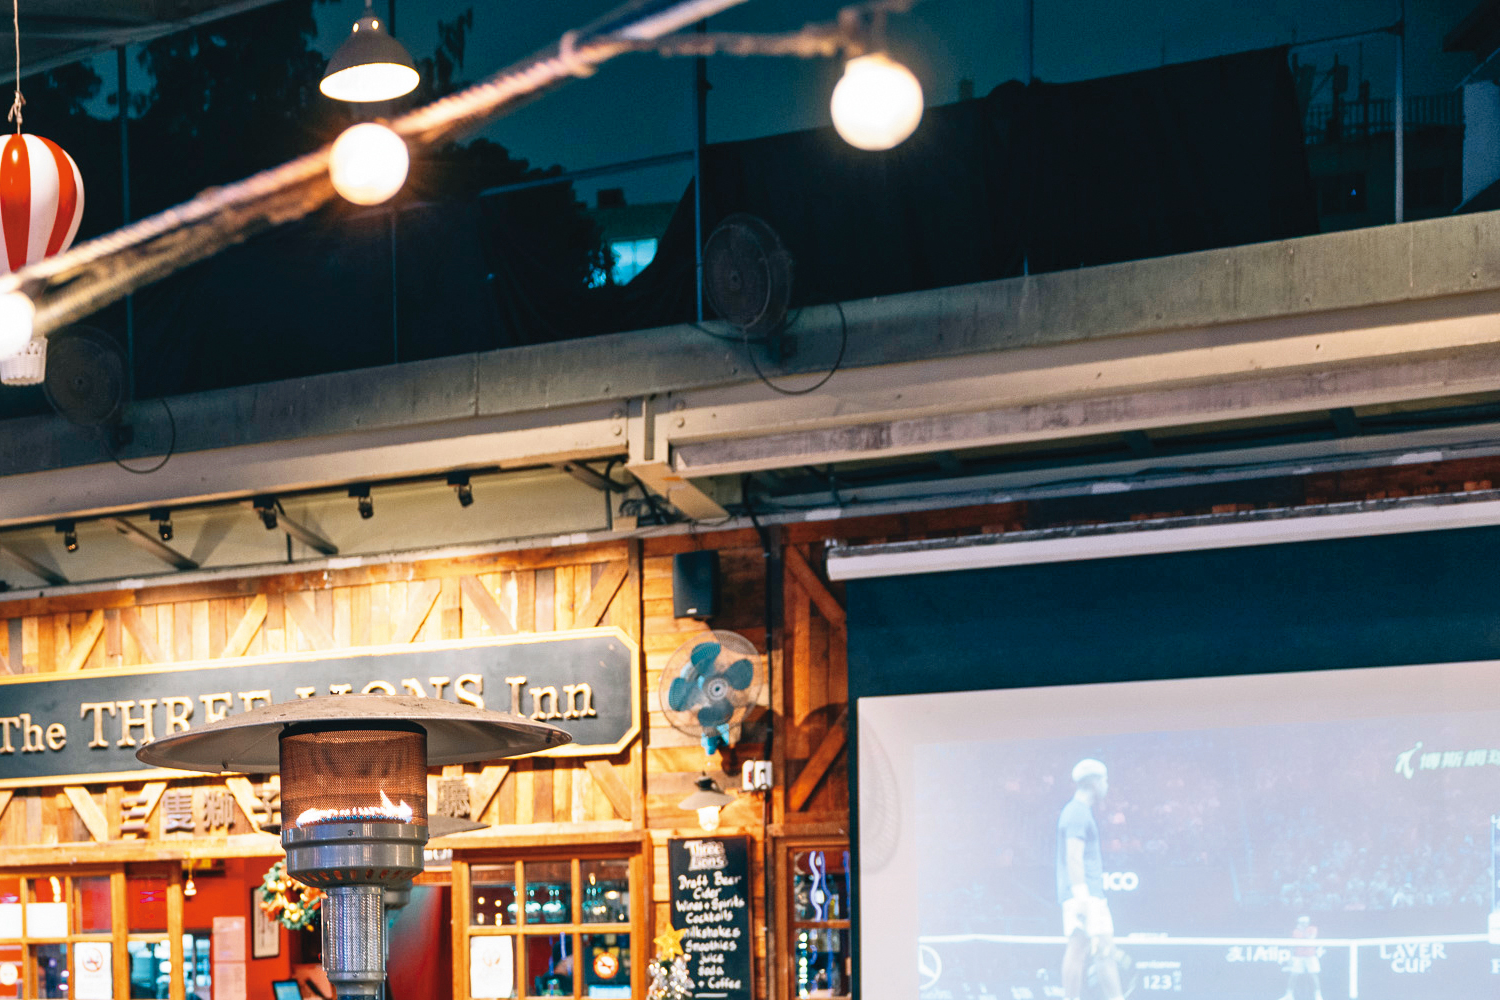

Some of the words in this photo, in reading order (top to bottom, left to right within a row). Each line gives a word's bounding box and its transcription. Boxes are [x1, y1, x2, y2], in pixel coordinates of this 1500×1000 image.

[505, 676, 597, 722] Inn
[678, 873, 708, 890] Draft
[713, 870, 743, 886] Beer
[693, 886, 722, 900] Cider
[676, 899, 704, 912] Wines
[685, 909, 734, 925] Cocktails
[685, 939, 737, 953] Smoothies
[1380, 944, 1447, 959] LAVER
[1391, 958, 1432, 973] CUP
[707, 976, 742, 990] Coffee
[1143, 975, 1172, 990] 123
